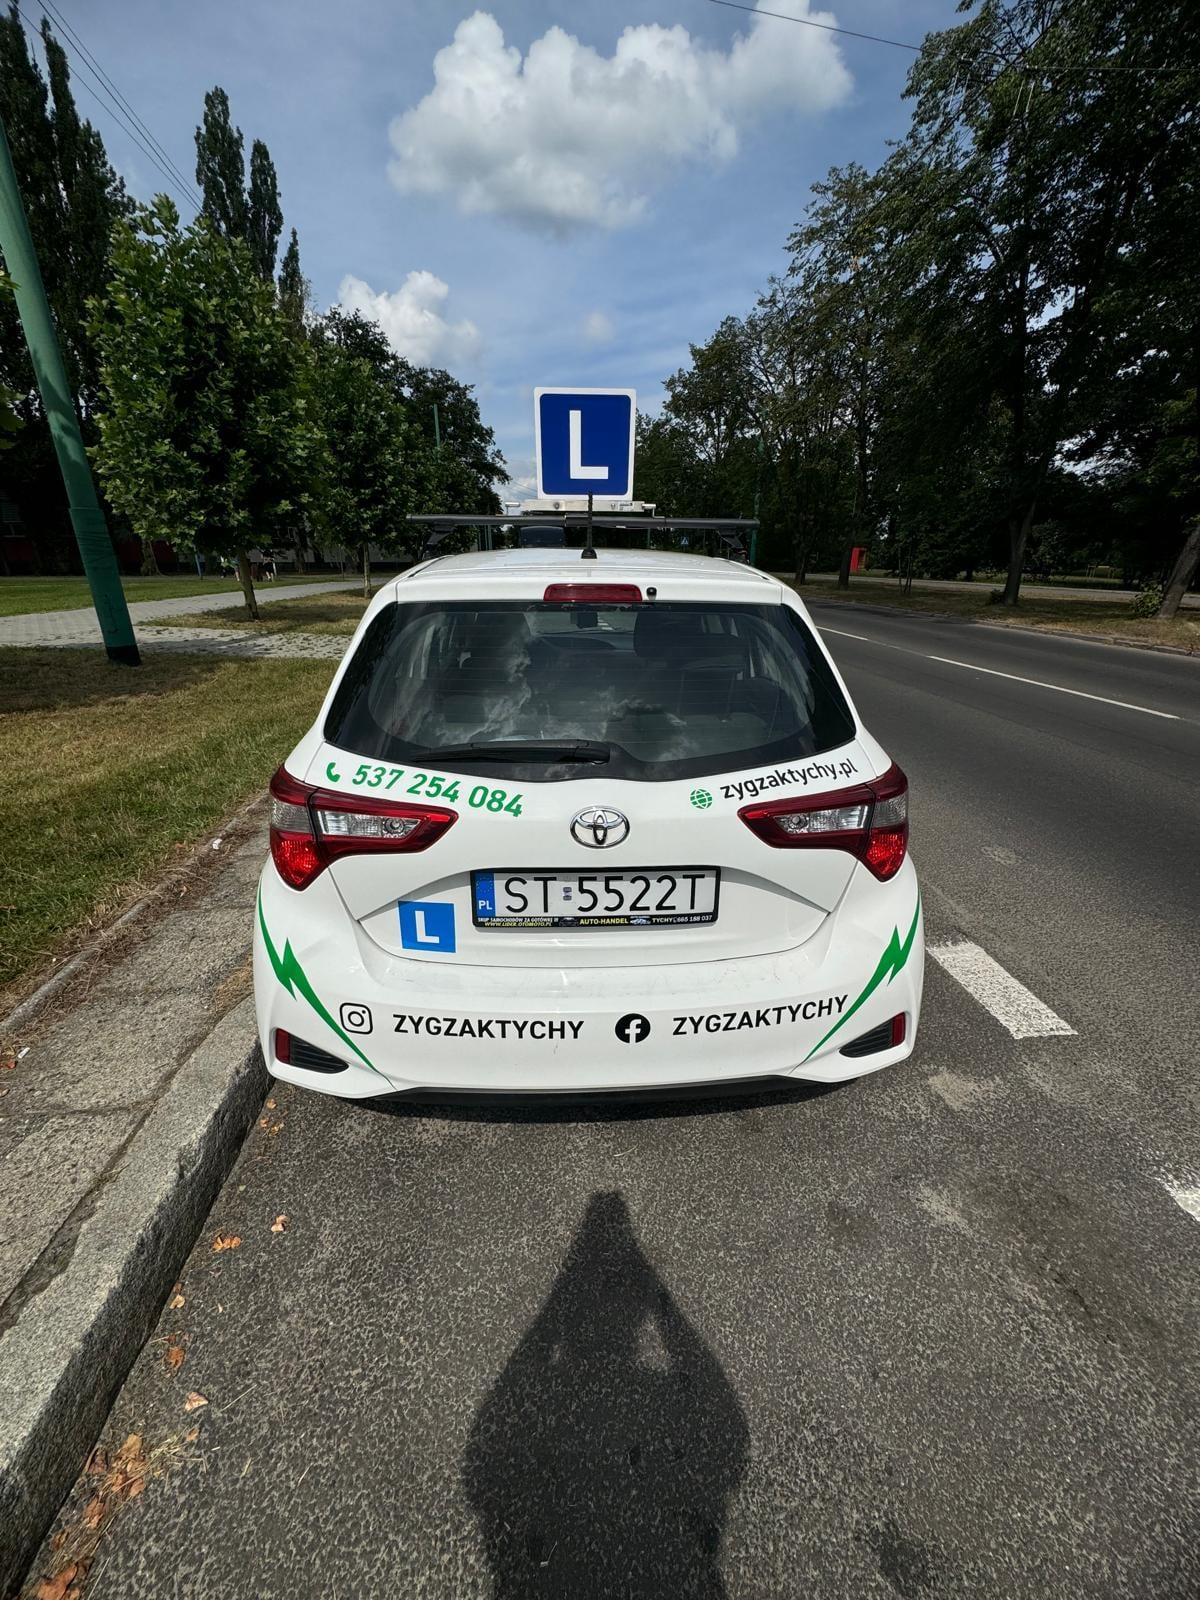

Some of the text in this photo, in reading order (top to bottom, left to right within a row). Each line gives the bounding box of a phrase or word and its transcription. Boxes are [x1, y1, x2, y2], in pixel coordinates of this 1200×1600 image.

[569, 410, 609, 479] L
[352, 764, 524, 818] 537 254 084
[720, 758, 858, 802] zygzaktychy.pl
[479, 900, 493, 910] PL
[504, 874, 706, 913] ST 5522T
[415, 910, 440, 944] L
[580, 917, 629, 925] AUTO-HANDEL
[392, 1014, 585, 1039] ZYGZAKTYCHY
[672, 994, 849, 1036] ZYGZAKTYCHY
